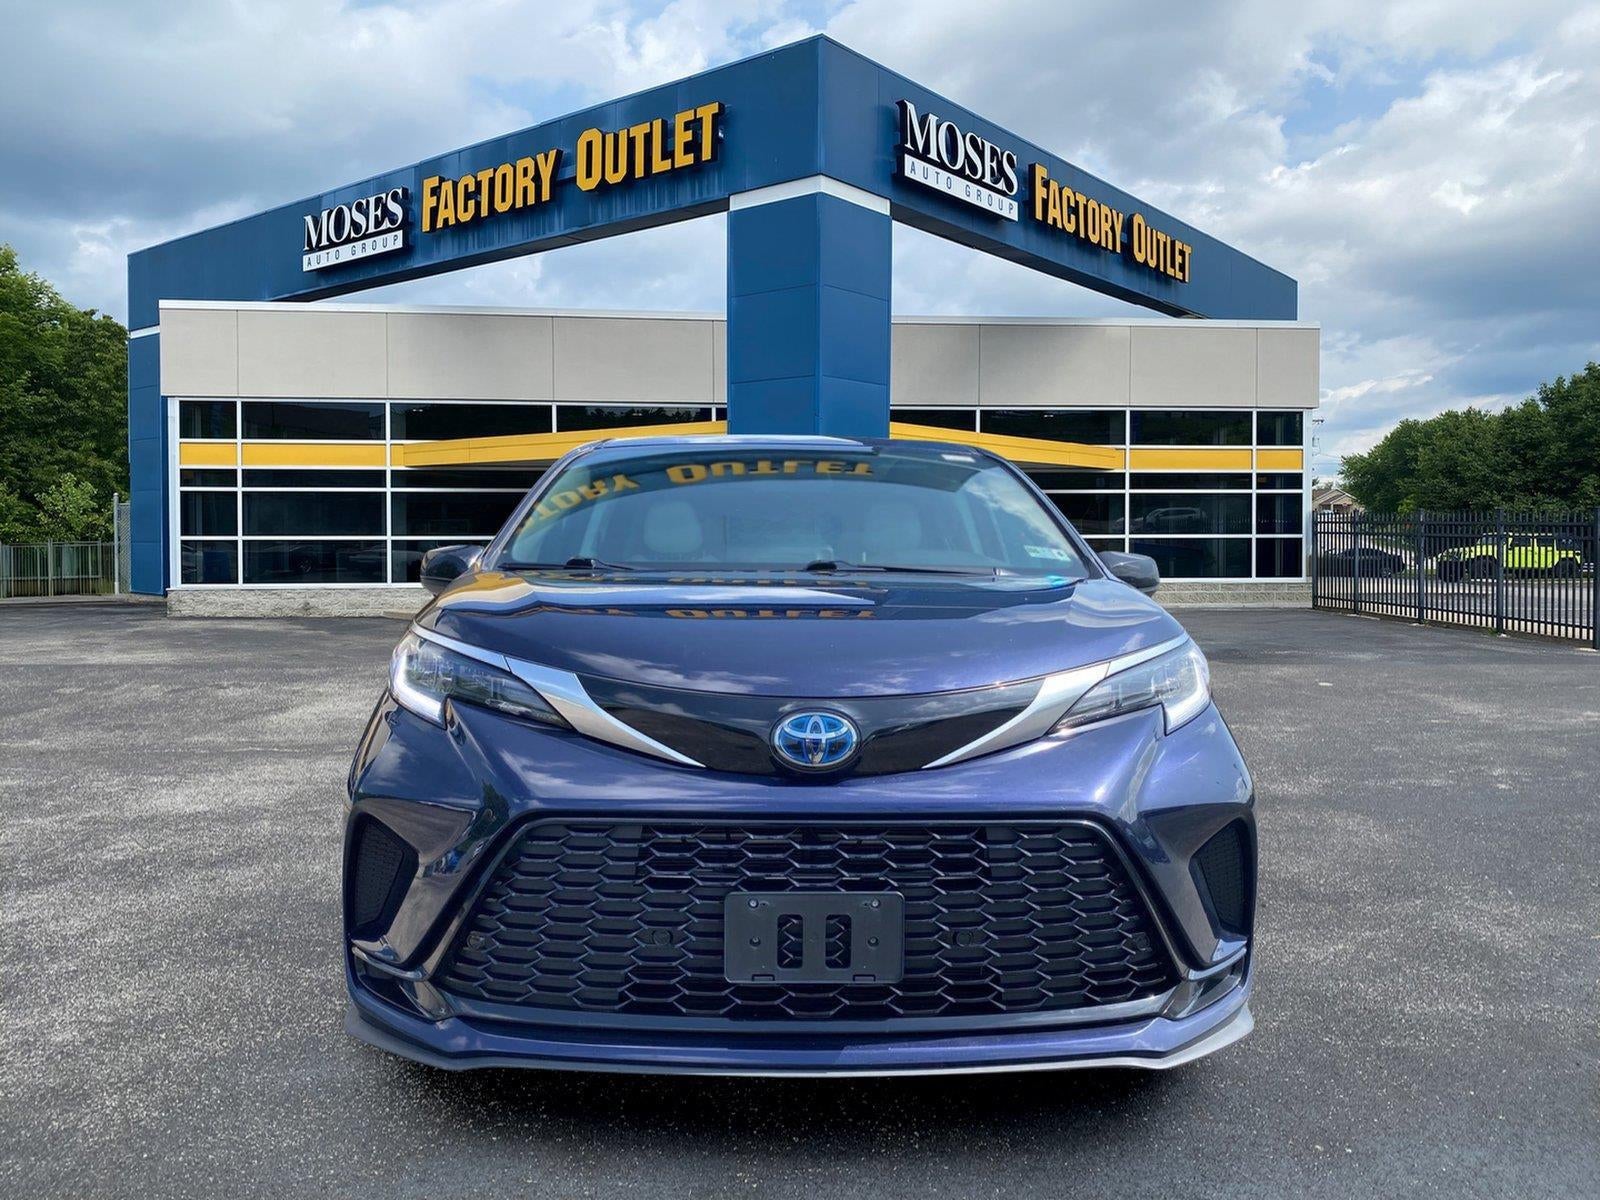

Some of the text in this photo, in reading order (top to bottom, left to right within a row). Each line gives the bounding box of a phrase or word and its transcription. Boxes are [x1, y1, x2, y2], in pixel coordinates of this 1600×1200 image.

[904, 99, 1019, 196] MOSES
[910, 161, 1014, 214] AUTO GROUP
[302, 187, 404, 251] MOSES
[307, 234, 399, 268] AUTO GROUP
